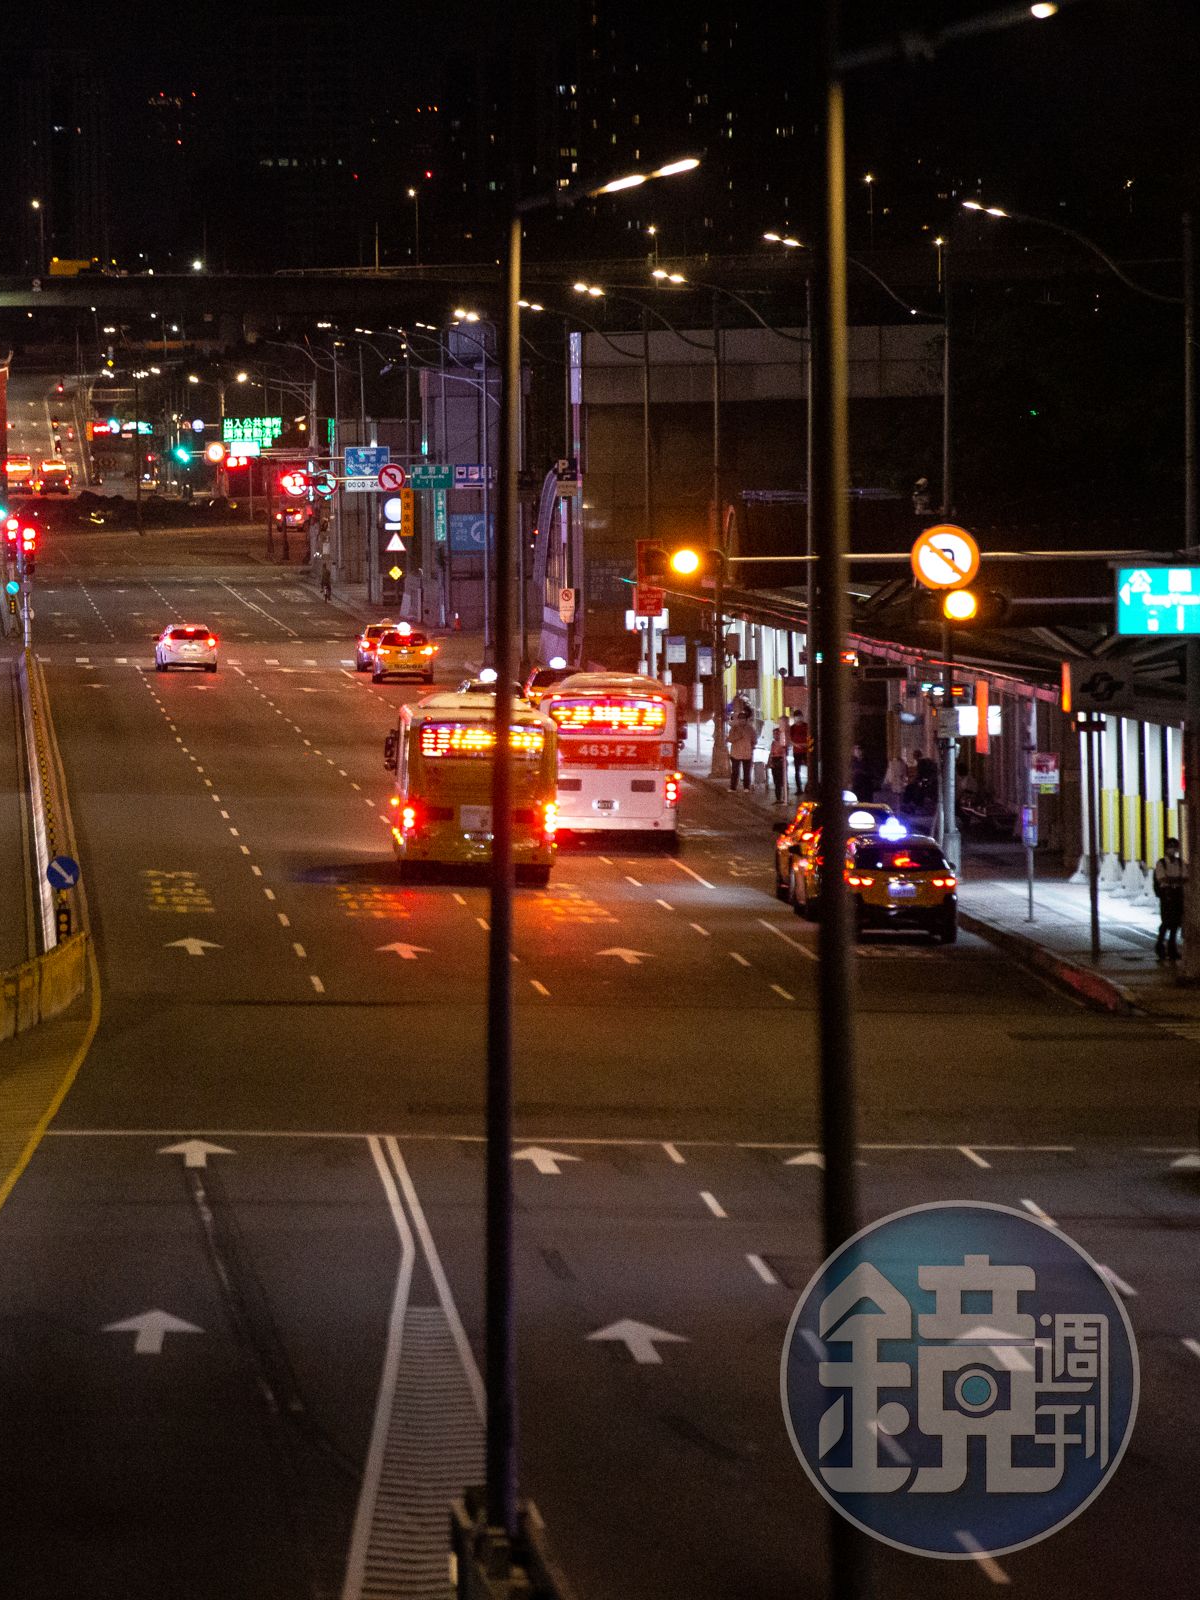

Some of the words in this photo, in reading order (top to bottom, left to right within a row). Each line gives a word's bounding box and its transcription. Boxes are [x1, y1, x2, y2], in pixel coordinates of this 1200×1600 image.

[223, 417, 282, 429] 出入公共場所
[558, 459, 569, 473] P
[578, 743, 638, 758] 463-FZ
